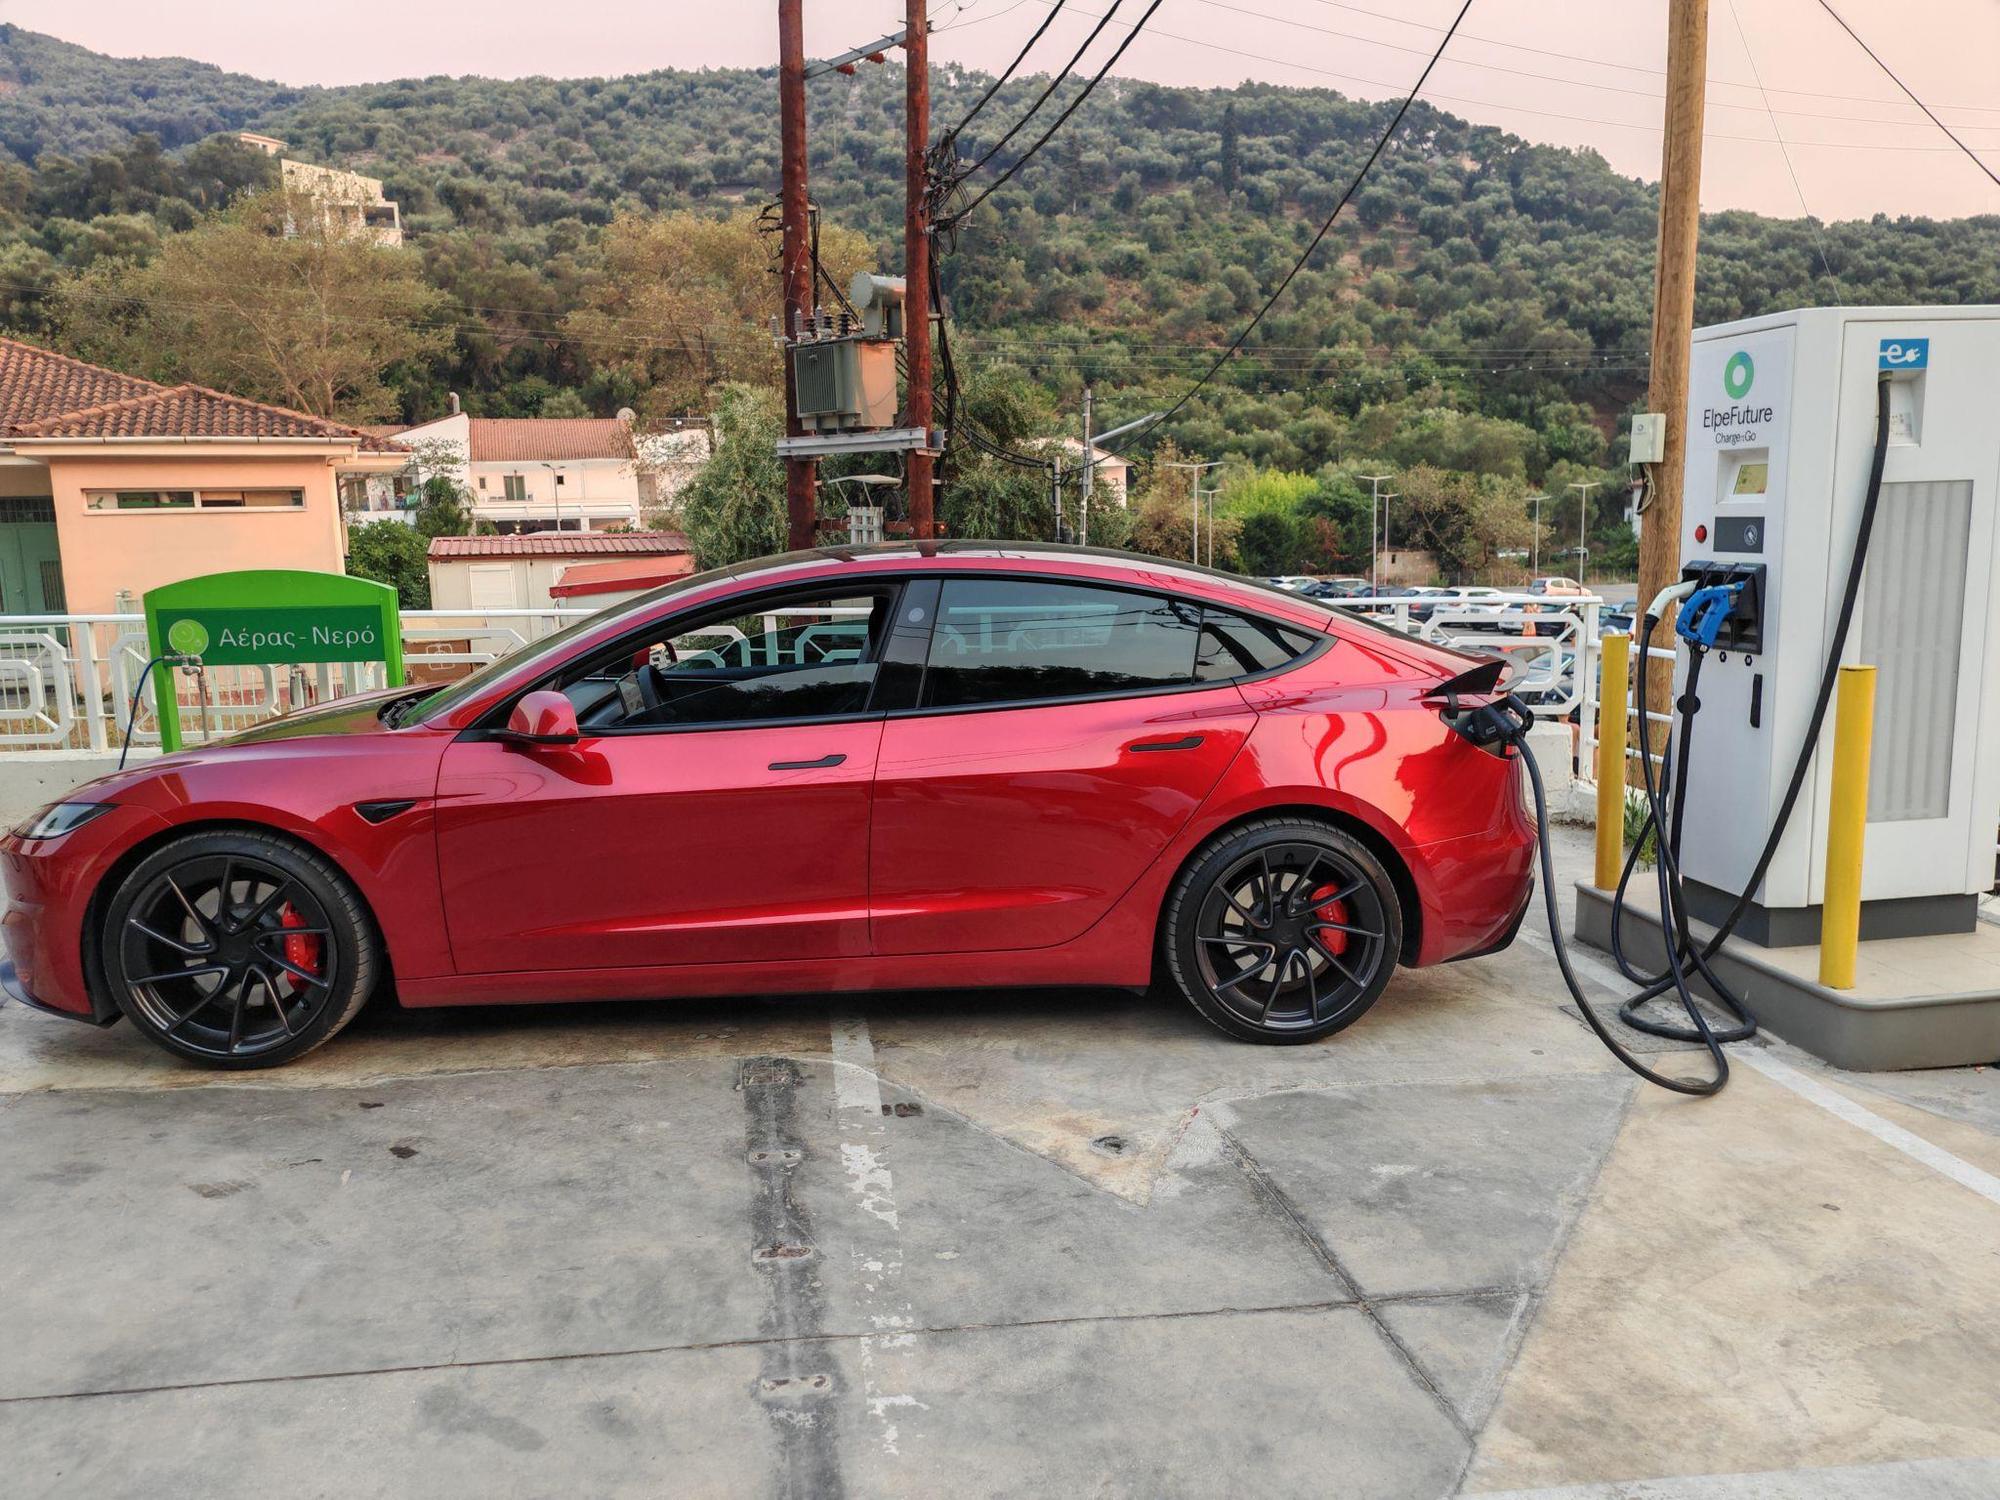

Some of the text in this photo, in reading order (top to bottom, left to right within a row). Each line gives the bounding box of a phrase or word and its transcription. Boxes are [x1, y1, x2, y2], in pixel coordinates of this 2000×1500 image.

[1703, 404, 1773, 432] ElpeFuture
[218, 627, 296, 651] Αέρας
[312, 625, 375, 649] Νερό
